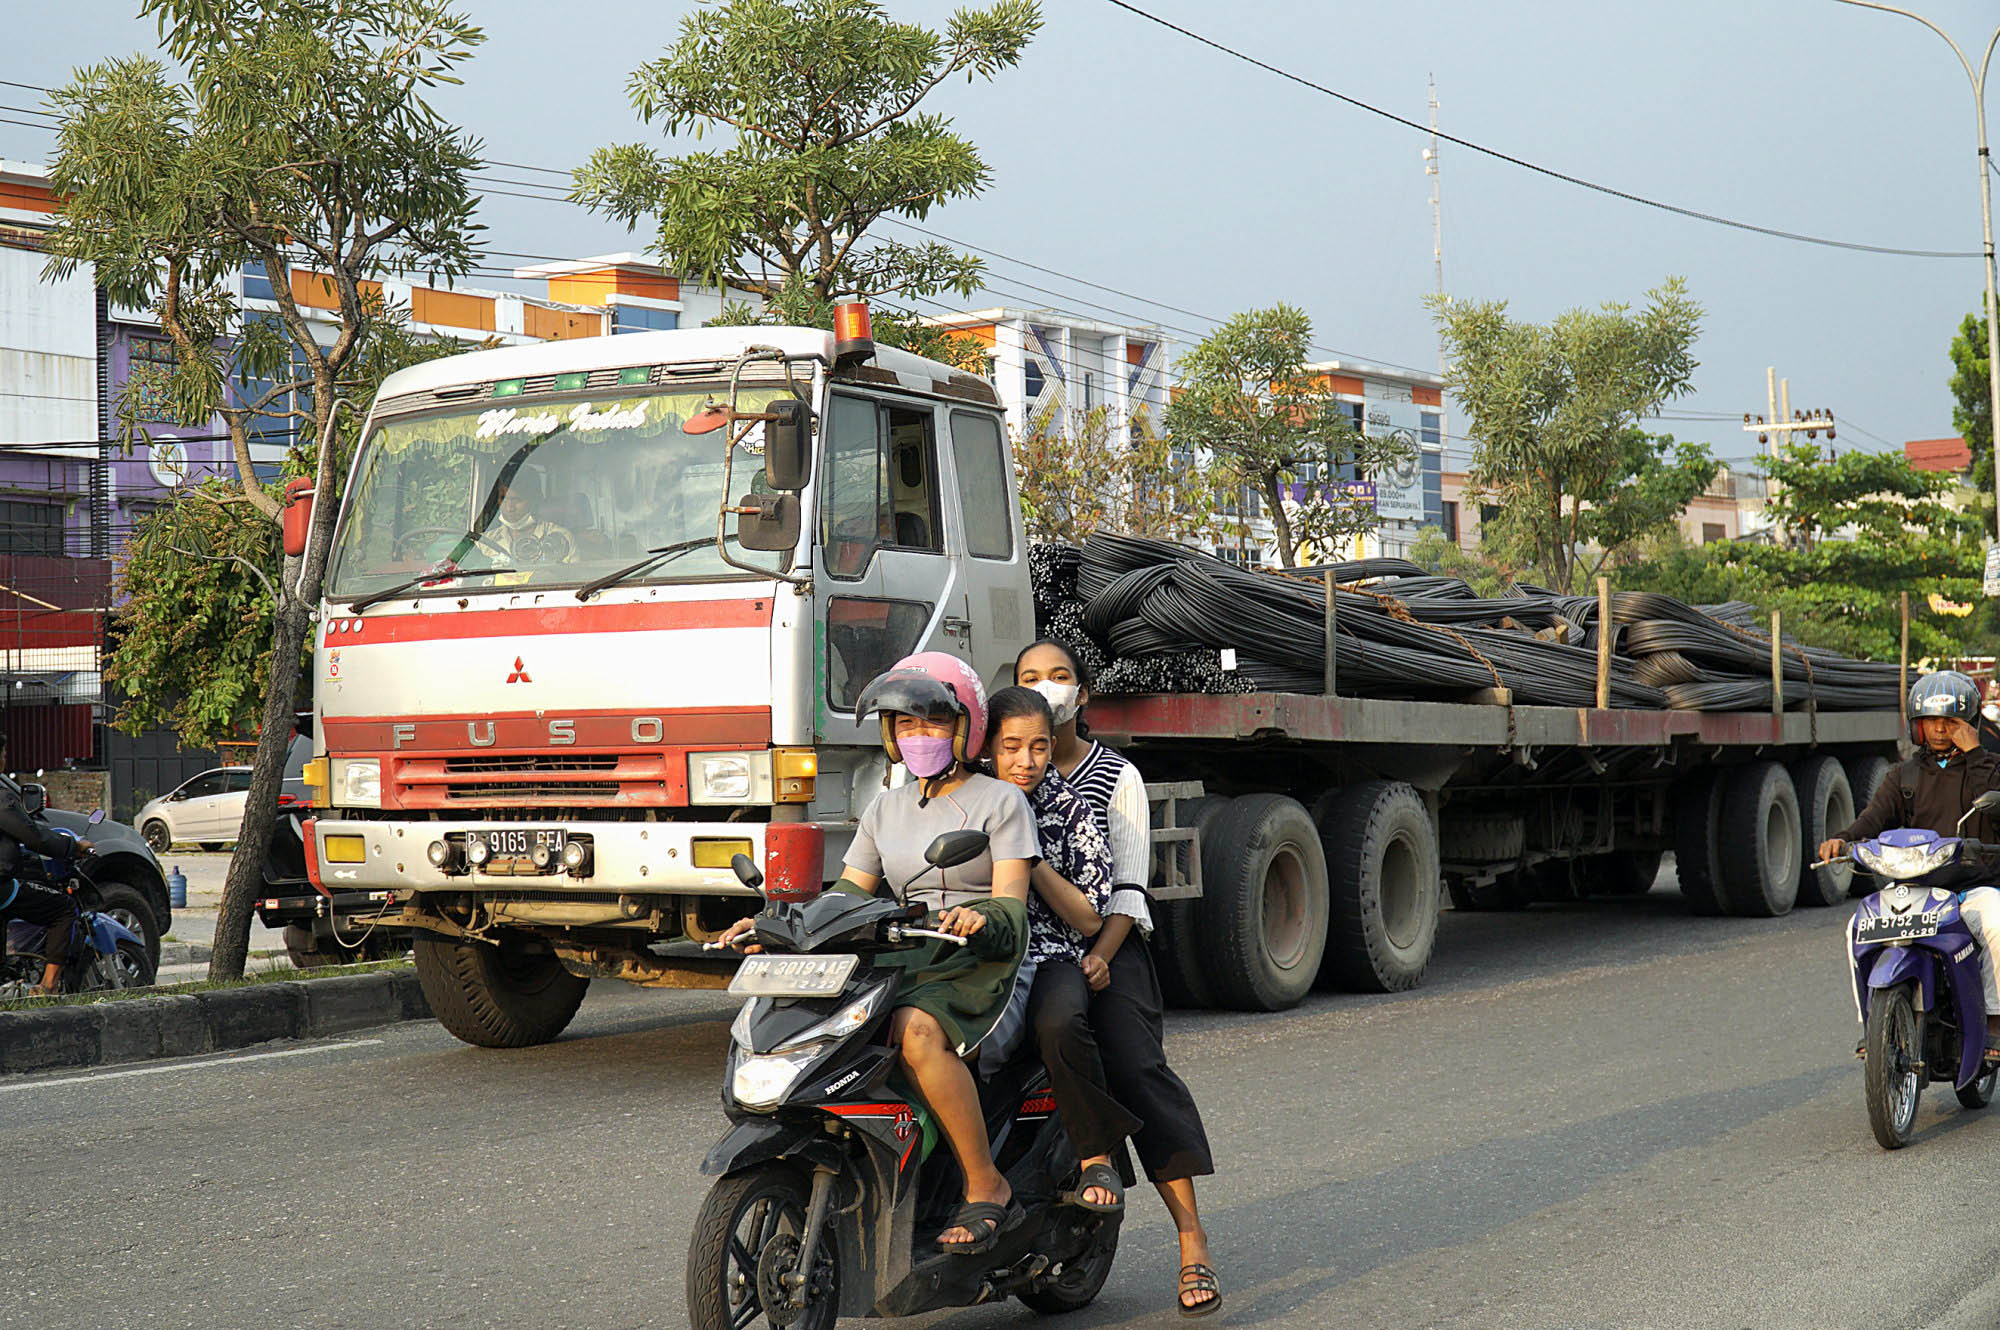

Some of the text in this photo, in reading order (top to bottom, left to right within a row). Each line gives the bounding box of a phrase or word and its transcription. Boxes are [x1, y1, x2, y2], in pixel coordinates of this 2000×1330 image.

[393, 717, 662, 748] FUSO
[490, 832, 527, 852] 9165
[1859, 918, 1875, 931] BM
[1881, 915, 1912, 929] 5752
[1954, 942, 1975, 963] YAMAHA
[743, 960, 770, 976] BM
[774, 961, 816, 975] 3019
[824, 1070, 860, 1095] HONDA
